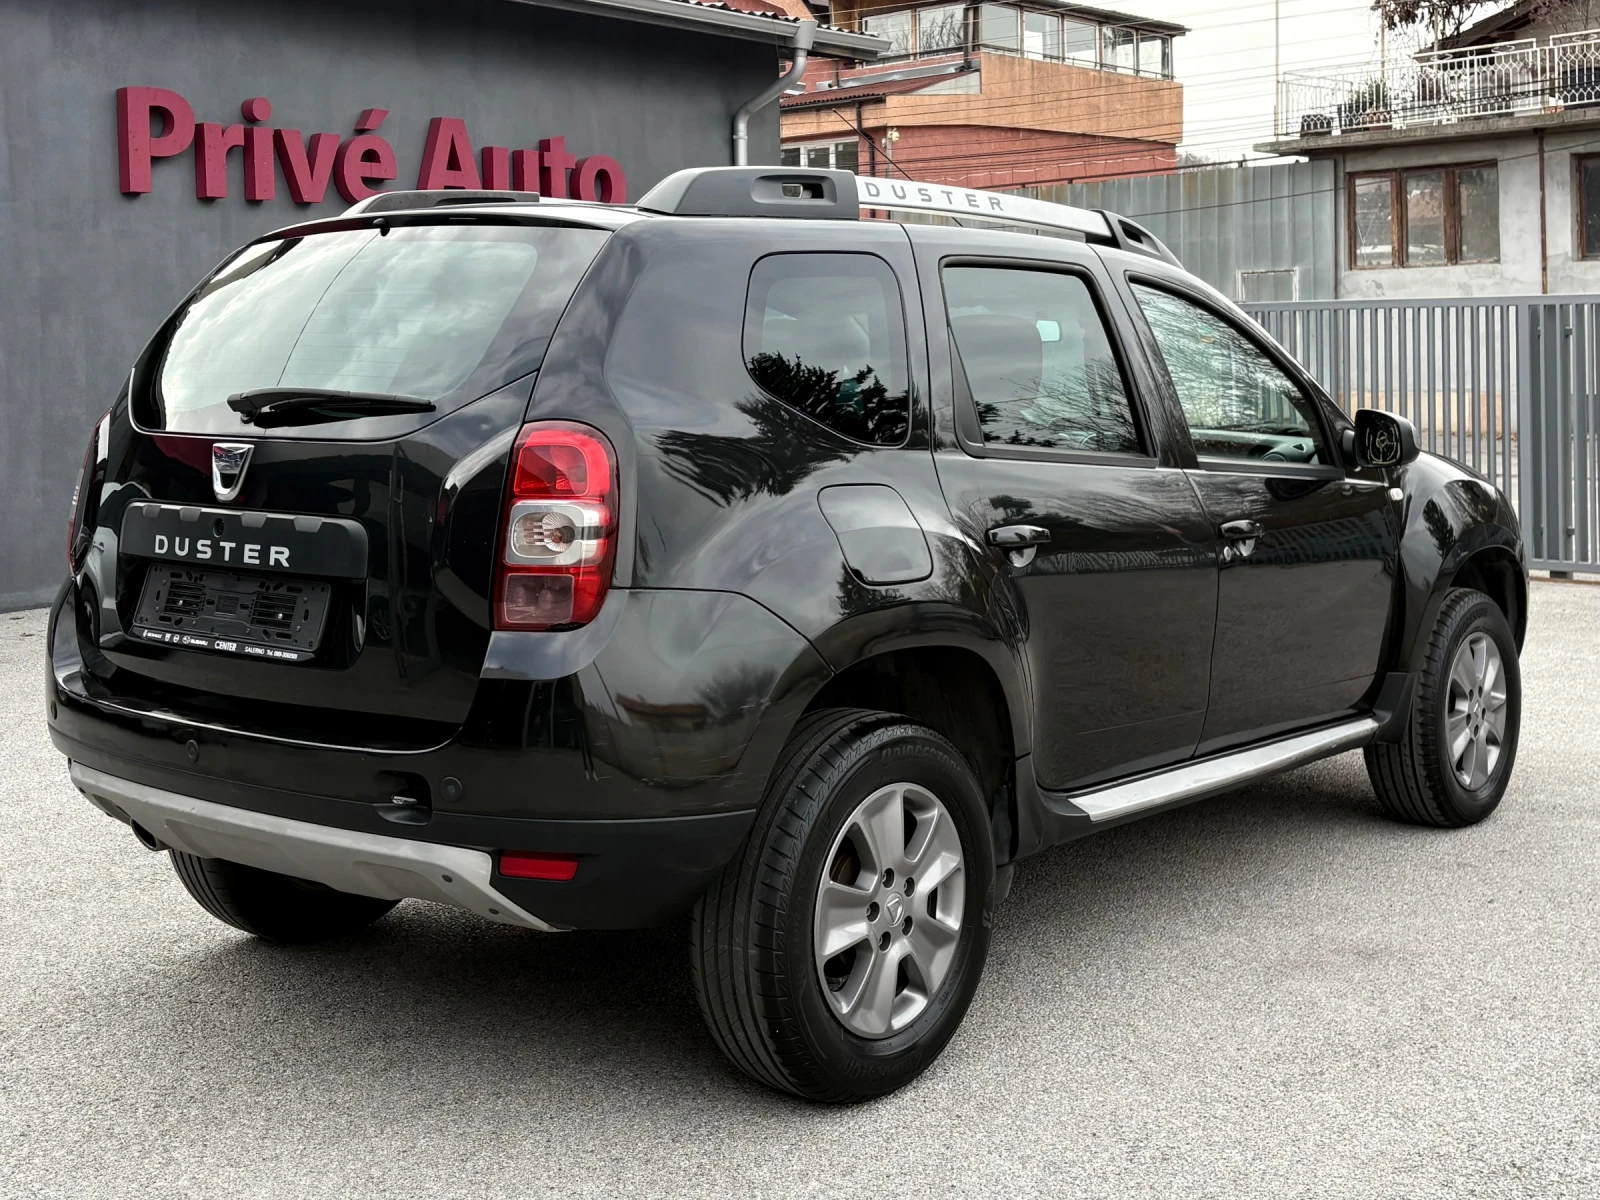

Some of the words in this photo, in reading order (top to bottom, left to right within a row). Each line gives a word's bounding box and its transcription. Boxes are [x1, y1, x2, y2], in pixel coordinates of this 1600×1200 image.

[117, 86, 396, 204] Privé
[416, 117, 627, 204] Auto
[864, 182, 1004, 211] DUSTER
[154, 535, 290, 567] DUSTER
[214, 640, 237, 652] CENTER
[244, 646, 265, 655] SALERNO
